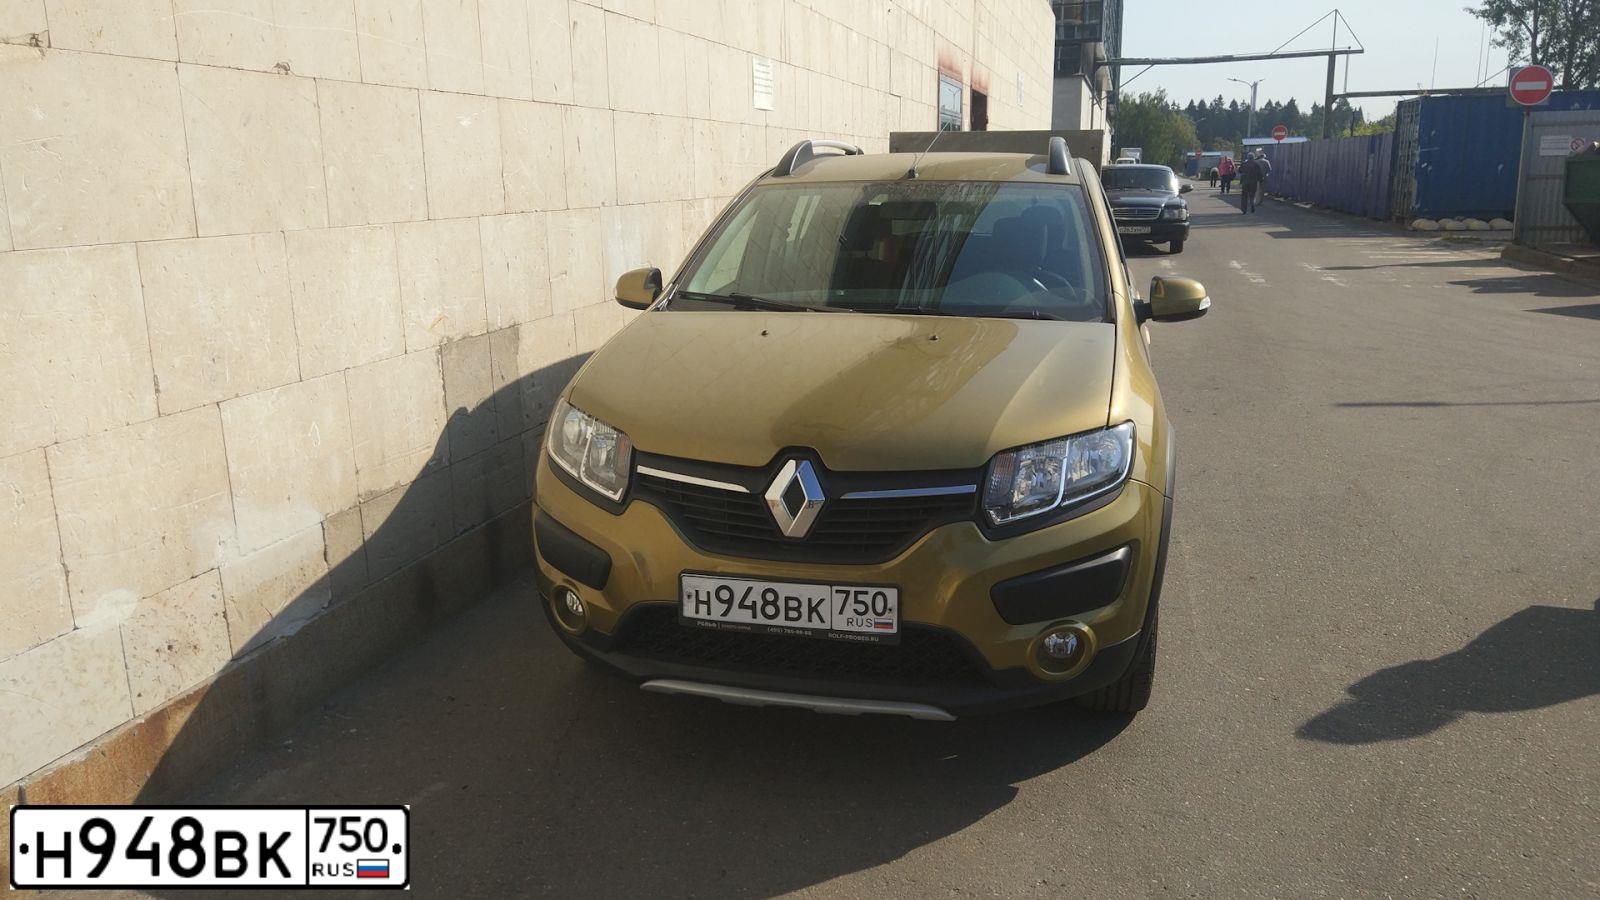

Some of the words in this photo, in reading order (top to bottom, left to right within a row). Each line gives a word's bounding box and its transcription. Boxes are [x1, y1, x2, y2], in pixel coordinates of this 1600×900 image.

[694, 584, 826, 624] Н948ВК
[835, 589, 888, 617] 750
[846, 617, 873, 628] RUS
